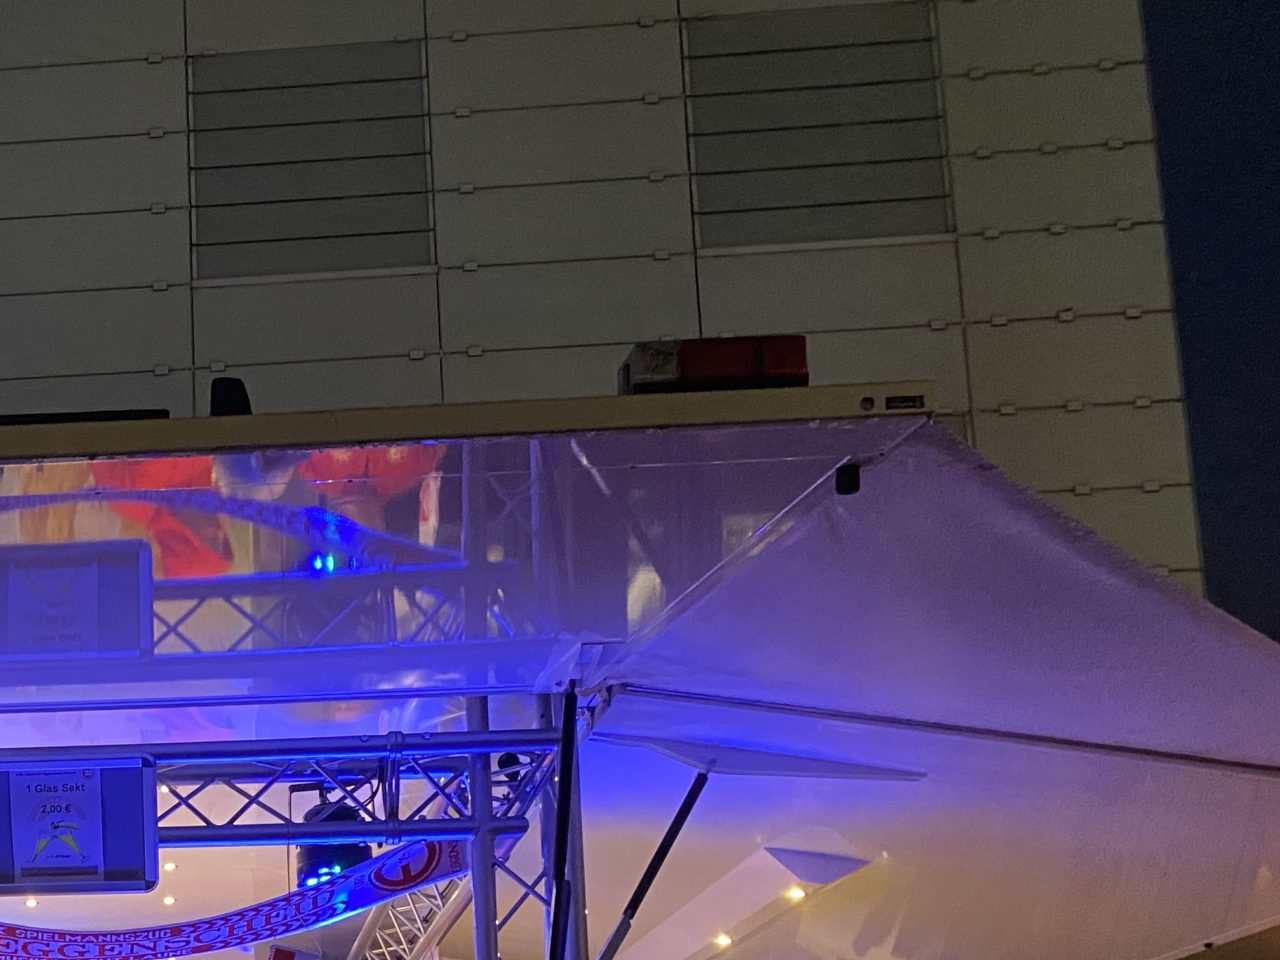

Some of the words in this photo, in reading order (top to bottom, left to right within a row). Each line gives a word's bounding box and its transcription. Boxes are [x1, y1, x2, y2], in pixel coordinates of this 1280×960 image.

[34, 784, 59, 793] Glas
[61, 783, 86, 793] Sekt
[40, 804, 62, 814] 2,00
[64, 803, 72, 813] €
[14, 928, 171, 945] SPIELMANNSZUG
